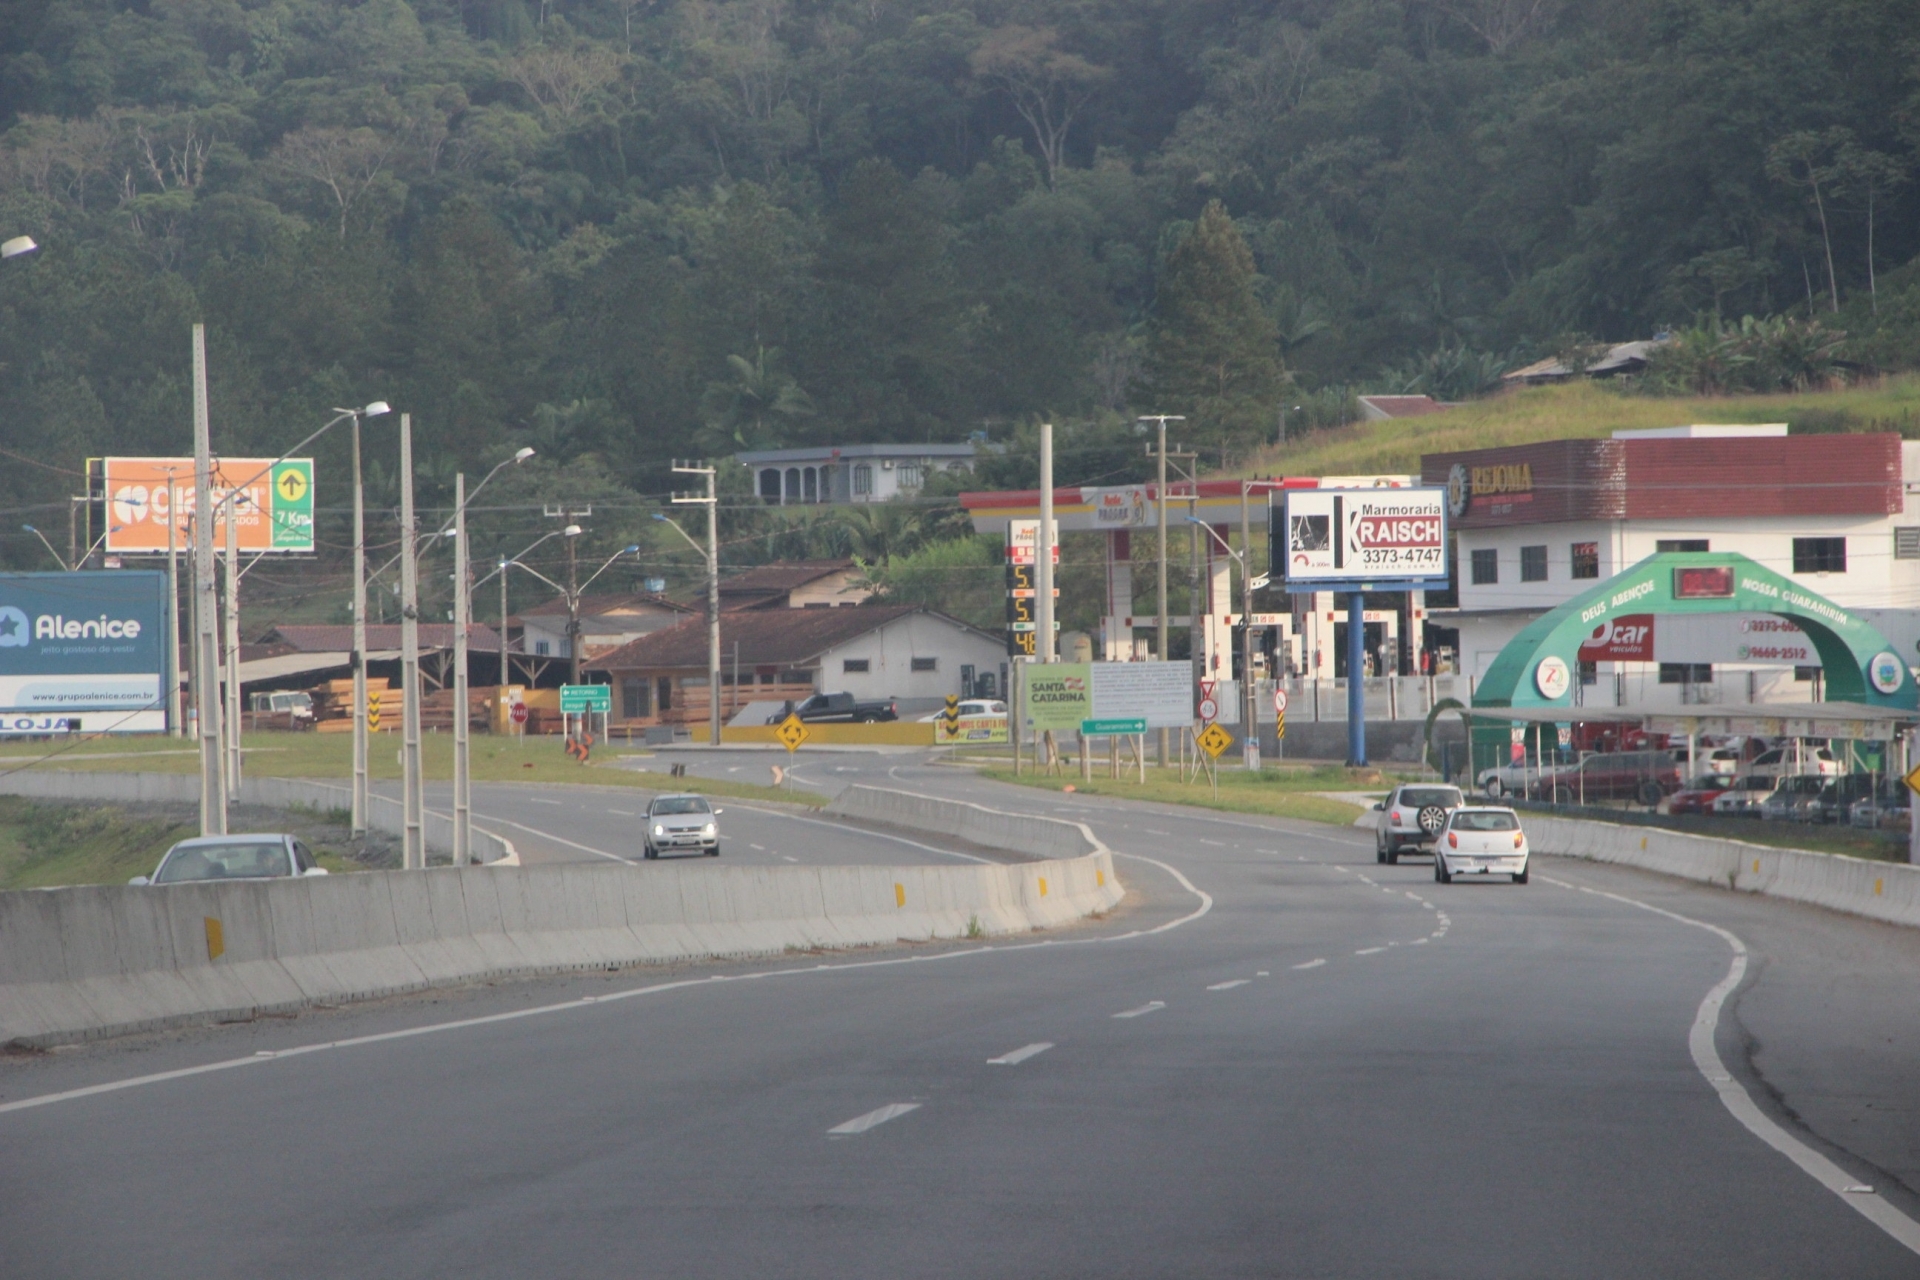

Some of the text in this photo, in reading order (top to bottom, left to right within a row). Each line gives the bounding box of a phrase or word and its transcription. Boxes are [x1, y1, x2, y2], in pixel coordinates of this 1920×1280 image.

[1471, 463, 1532, 495] REJOMA
[1362, 503, 1441, 516] Marmoraria
[277, 511, 286, 523] 7
[1363, 549, 1442, 564] 3373-4747
[1582, 601, 1607, 623] DEUS
[1612, 580, 1655, 609] ABENÇOE
[1741, 578, 1779, 598] NOSSA
[1782, 590, 1848, 625] GUARAMIRIM
[35, 614, 141, 640] Alenice
[41, 645, 135, 655] jeito gostoso de vestir
[1032, 683, 1066, 692] SANTA
[32, 692, 154, 702] www.grupoalenice.com.br
[1032, 693, 1086, 703] CATARINA
[513, 708, 527, 717] PARE
